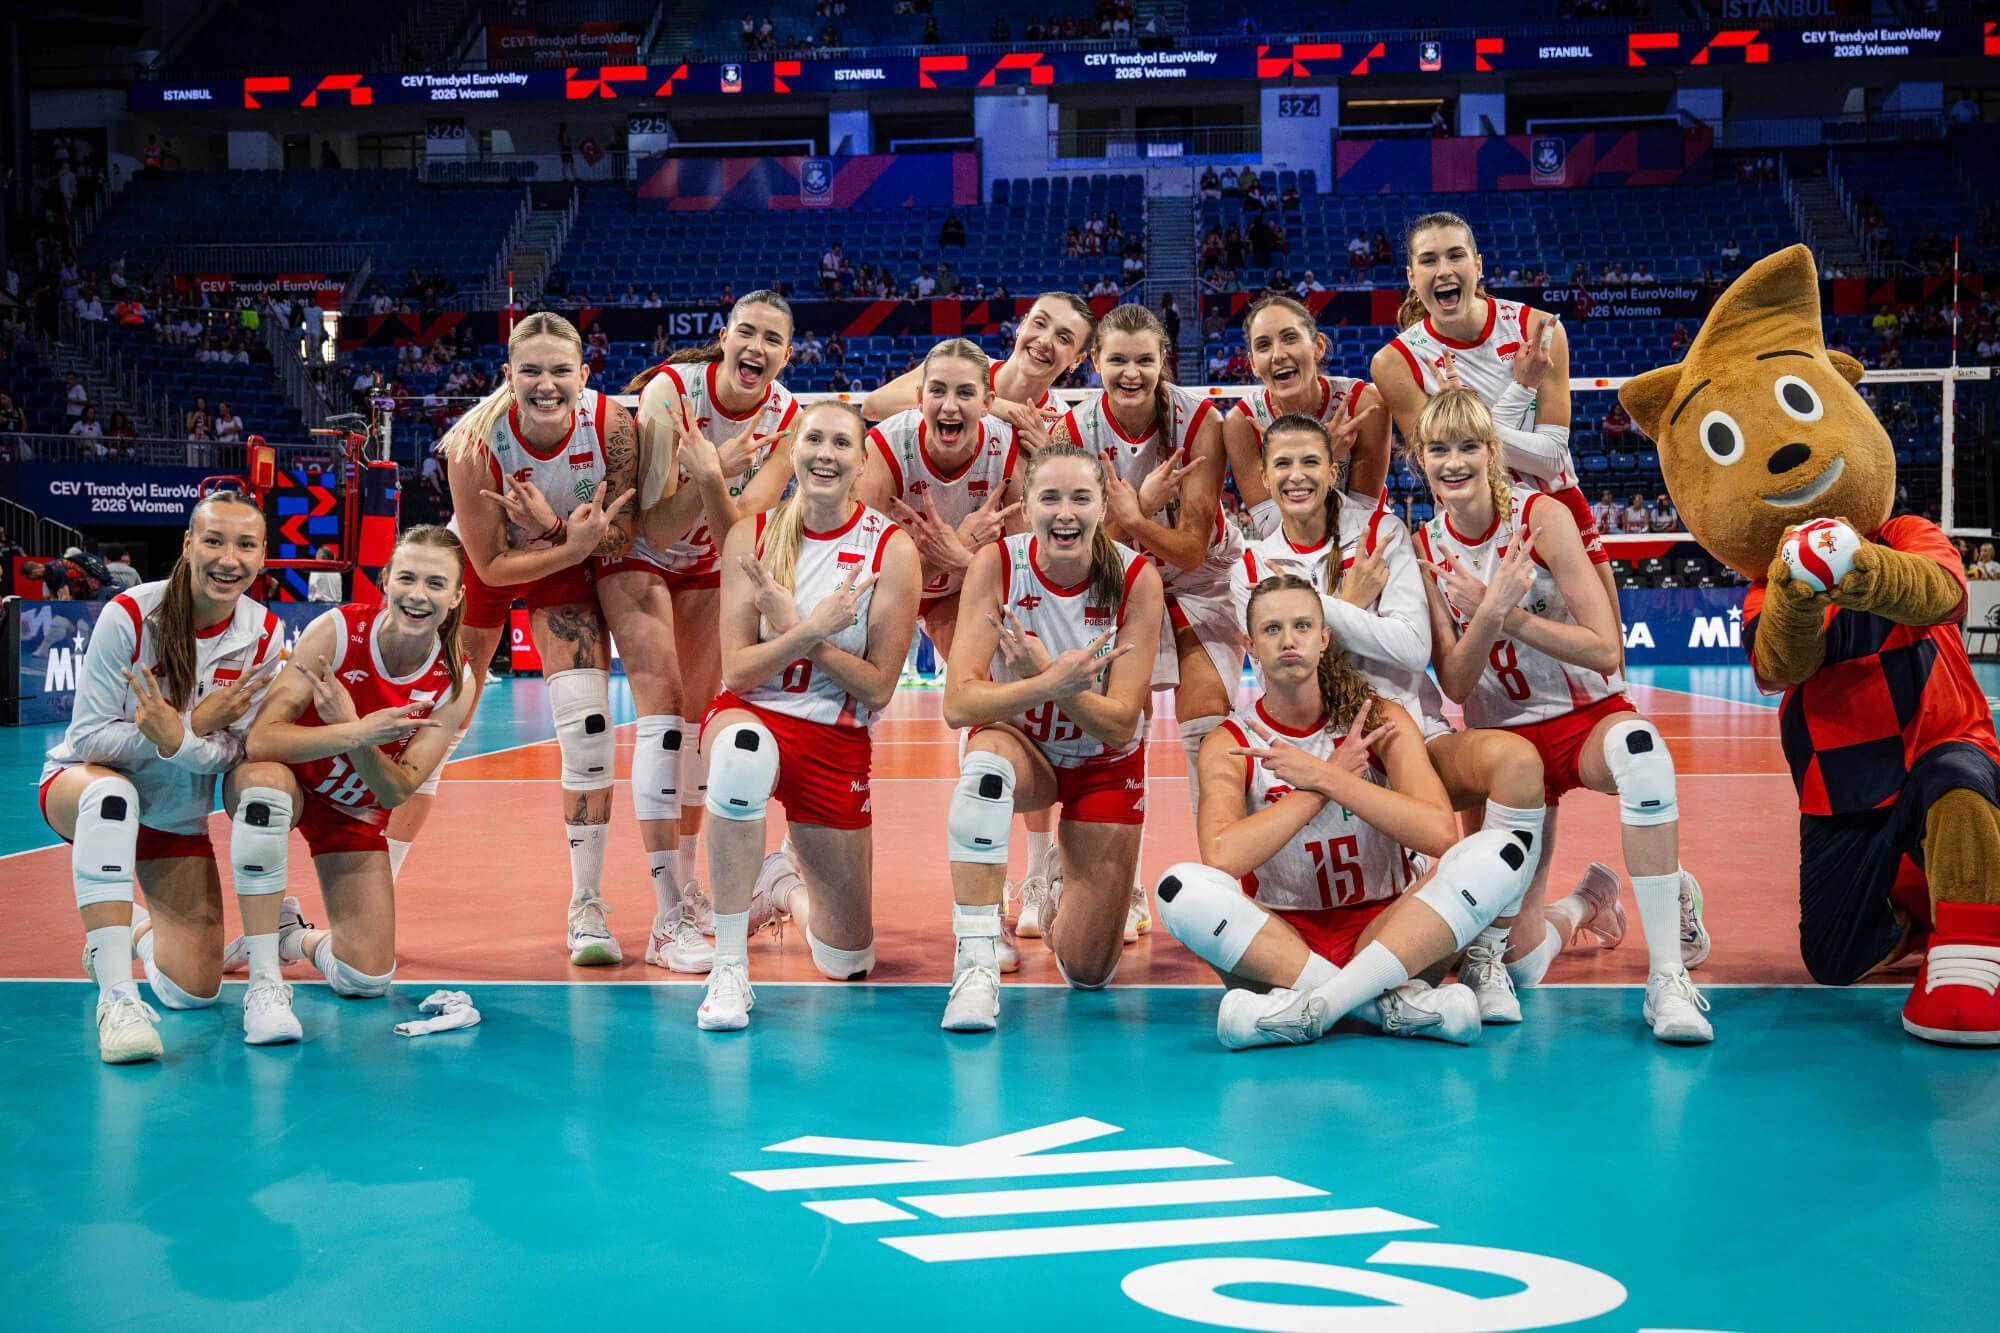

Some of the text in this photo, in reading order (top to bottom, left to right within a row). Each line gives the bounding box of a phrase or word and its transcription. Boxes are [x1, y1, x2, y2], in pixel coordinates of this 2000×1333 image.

[1722, 0, 1836, 18] ISTANBUL
[502, 31, 642, 48] CEV Trendyol EuroVolley
[1801, 27, 1941, 43] CEV Trendyol EuroVolley
[1084, 51, 1217, 66] CEV Trendyol EuroVolley
[1539, 46, 1593, 58] ISTANBUL
[1834, 45, 1909, 57] 2026 Women
[401, 73, 528, 87] CEV Trendyol EuroVolley
[834, 68, 886, 80] ISTANBUL
[1115, 67, 1186, 79] 2026 Women
[163, 89, 212, 100] ISTANBUL
[431, 88, 499, 100] 2026 Women
[1281, 100, 1318, 116] 324
[429, 125, 465, 139] 326
[628, 118, 667, 134] 325
[200, 281, 226, 292] CEV
[283, 279, 346, 293] EuroVolley
[1542, 290, 1571, 302] CEV
[1630, 287, 1698, 301] EuroVolley
[1613, 304, 1661, 317] Women
[50, 480, 82, 496] CEV
[84, 482, 148, 500] Trendyol
[91, 498, 185, 513] 2026 Women
[1016, 593, 1042, 611] 4F
[342, 669, 369, 684] 4F
[1488, 638, 1532, 701] 8
[313, 755, 370, 805] 18
[1304, 834, 1366, 909] 15
